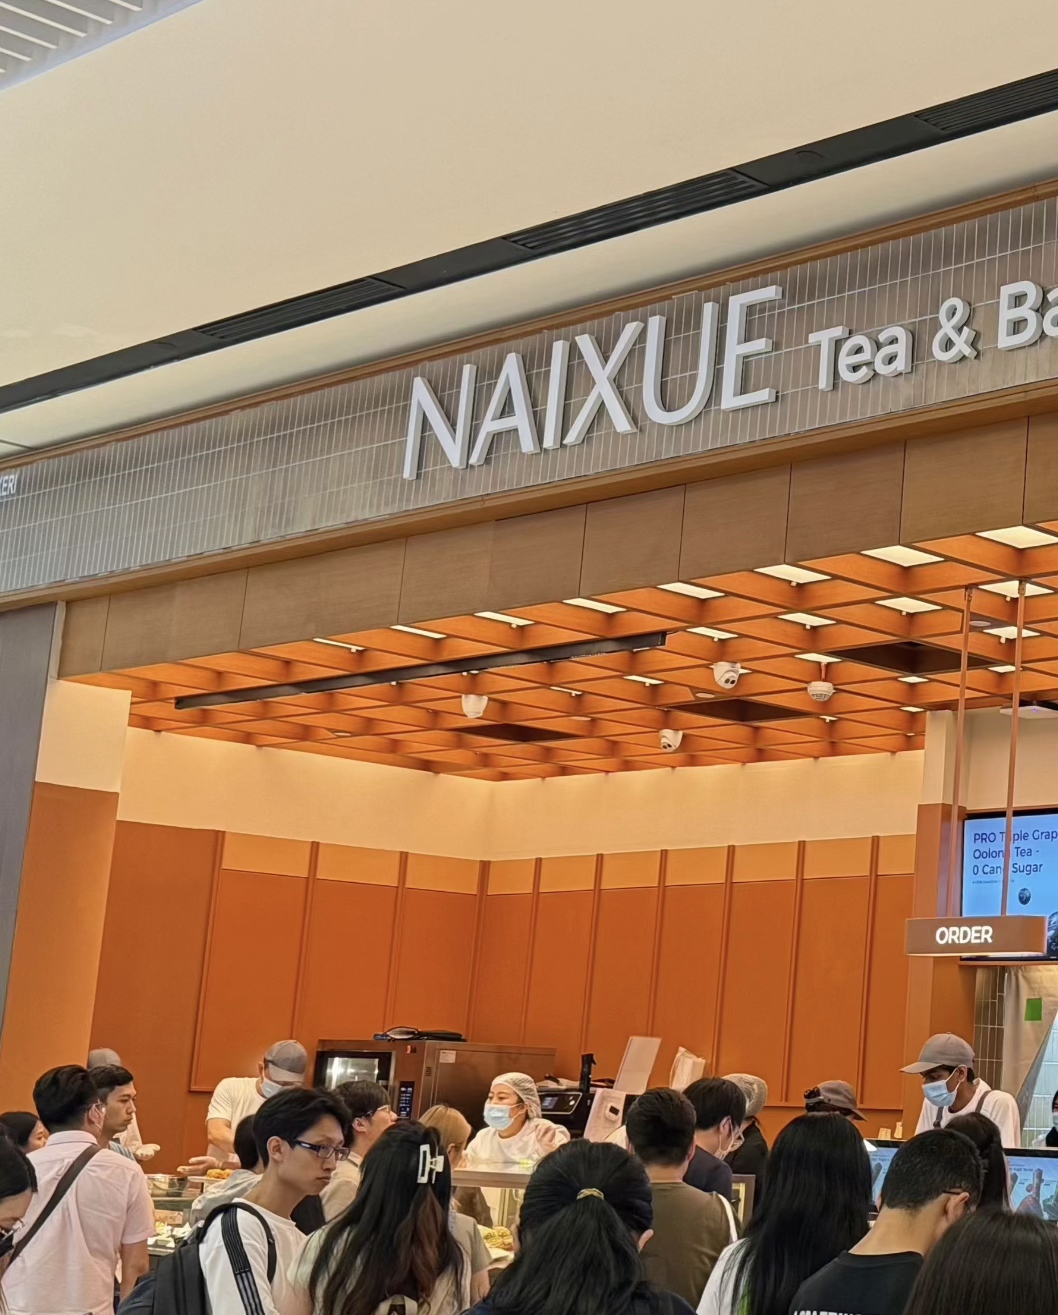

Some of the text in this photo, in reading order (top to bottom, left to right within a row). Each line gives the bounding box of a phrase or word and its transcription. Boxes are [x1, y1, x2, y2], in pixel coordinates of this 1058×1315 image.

[403, 285, 782, 481] NAIXUE
[808, 324, 912, 391] Tea
[931, 296, 977, 363] &
[974, 832, 996, 844] PRO
[999, 830, 1029, 844] Tple
[973, 847, 1032, 860] Oolon Tea
[972, 863, 1044, 876] 0 Can Sugar
[935, 926, 993, 945] ORDER
